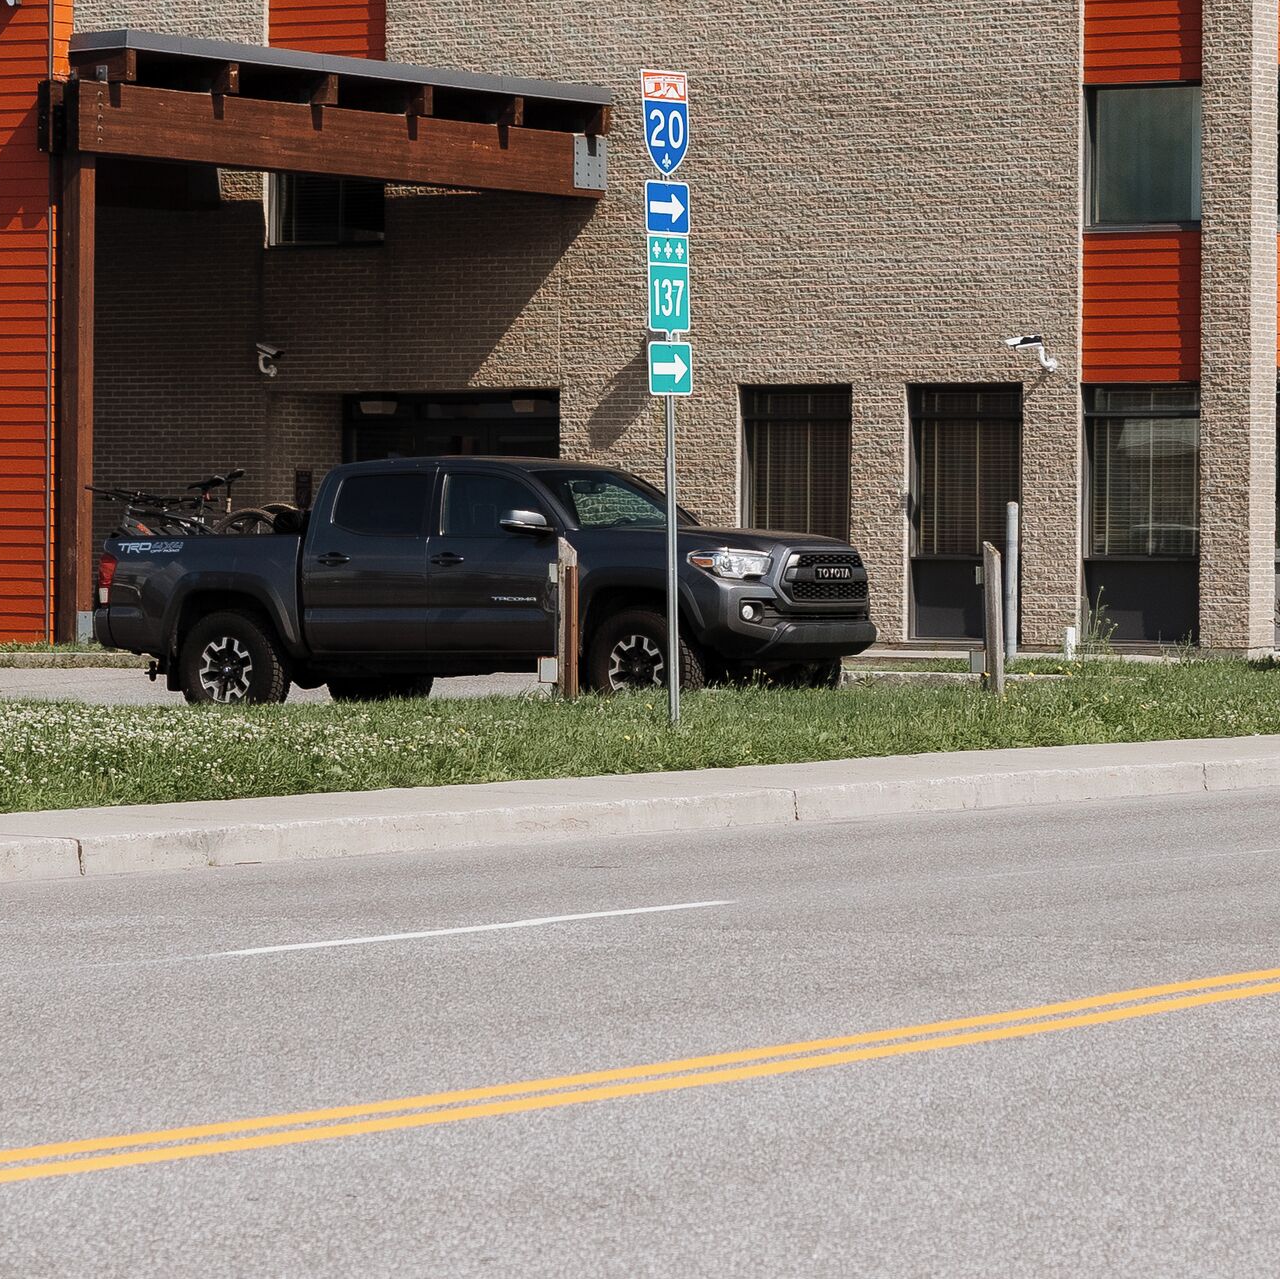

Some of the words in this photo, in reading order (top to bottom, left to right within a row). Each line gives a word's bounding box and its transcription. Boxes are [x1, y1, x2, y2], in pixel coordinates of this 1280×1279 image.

[649, 109, 684, 149] 20
[653, 278, 685, 317] 137
[118, 542, 152, 554] TRD
[817, 568, 851, 578] TOYOTA
